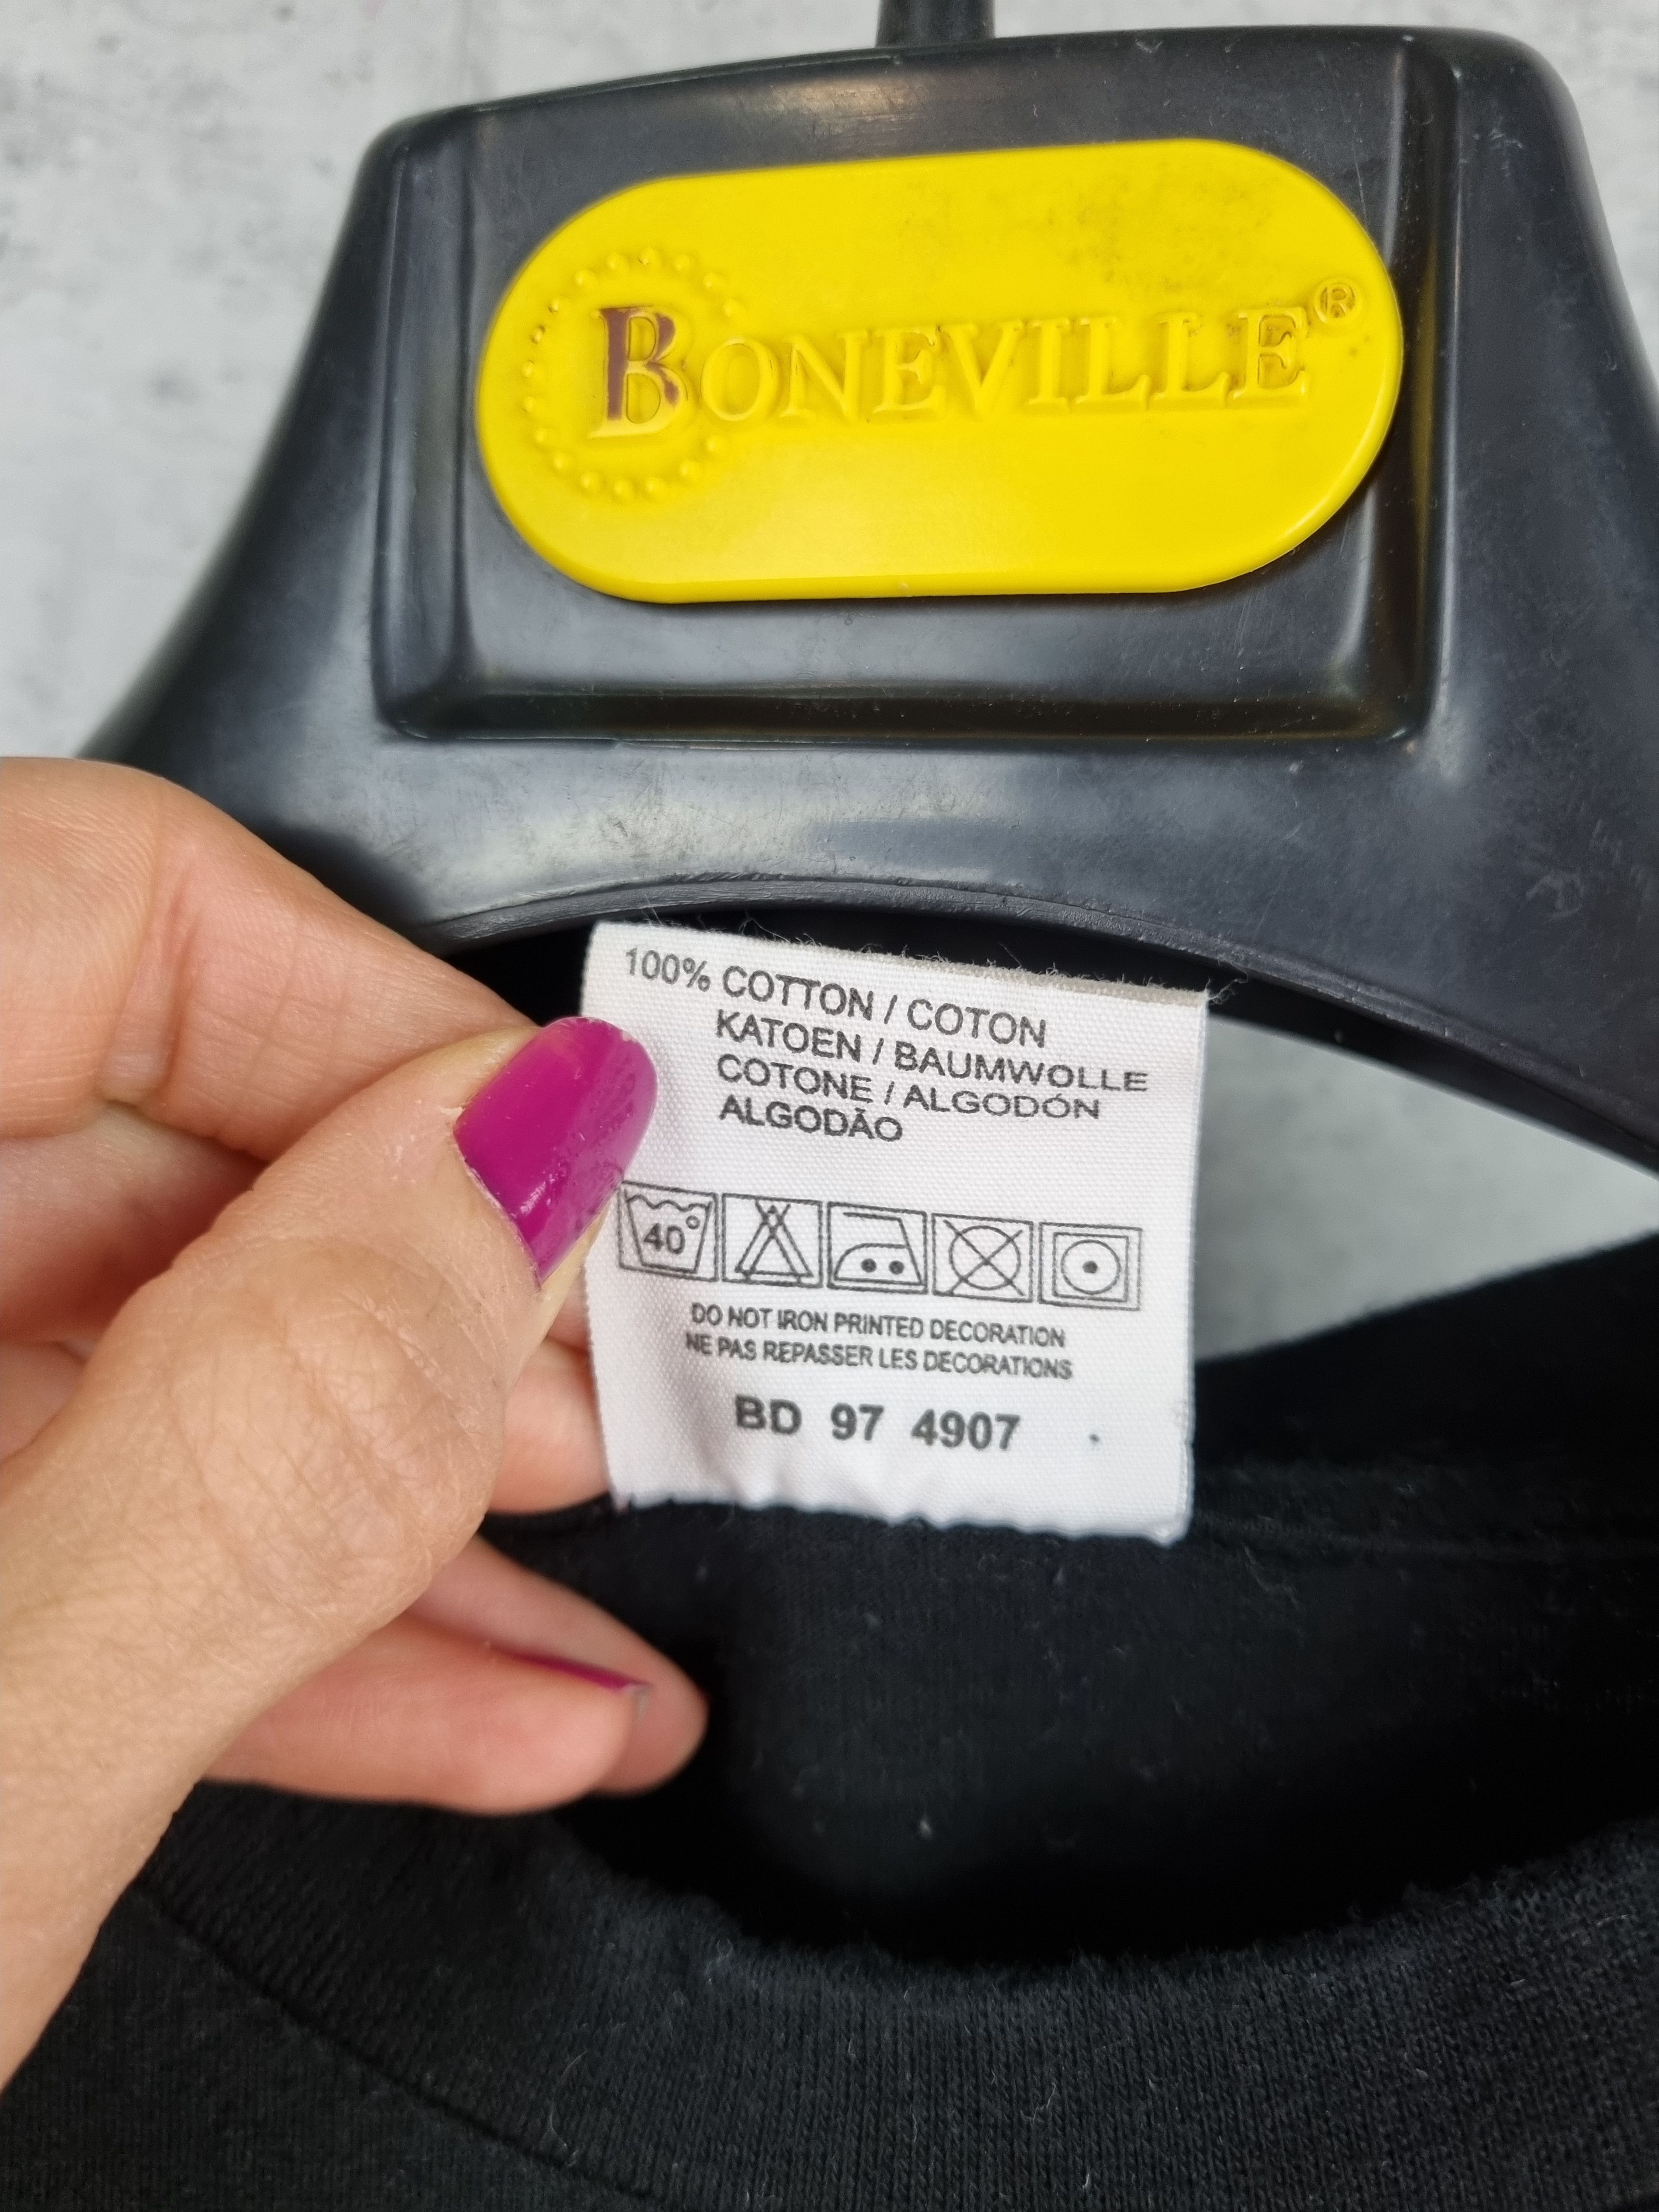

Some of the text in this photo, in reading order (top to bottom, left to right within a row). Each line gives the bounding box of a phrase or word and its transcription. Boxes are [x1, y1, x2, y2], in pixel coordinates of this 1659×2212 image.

[626, 947, 1046, 1047] 100% COTTON / COTON
[717, 1010, 1148, 1092] KATOEN / BAUMWOLLE
[717, 1054, 1100, 1119] COTONE / ALGODÓN
[719, 1095, 903, 1142] ALGODÃO
[691, 1303, 1065, 1347] DO NOT IRON PRINTED DECORATION
[684, 1332, 1073, 1380] NE PAS REPASSER LES DECORATIONS
[734, 1395, 1021, 1450] BD 97 4907
